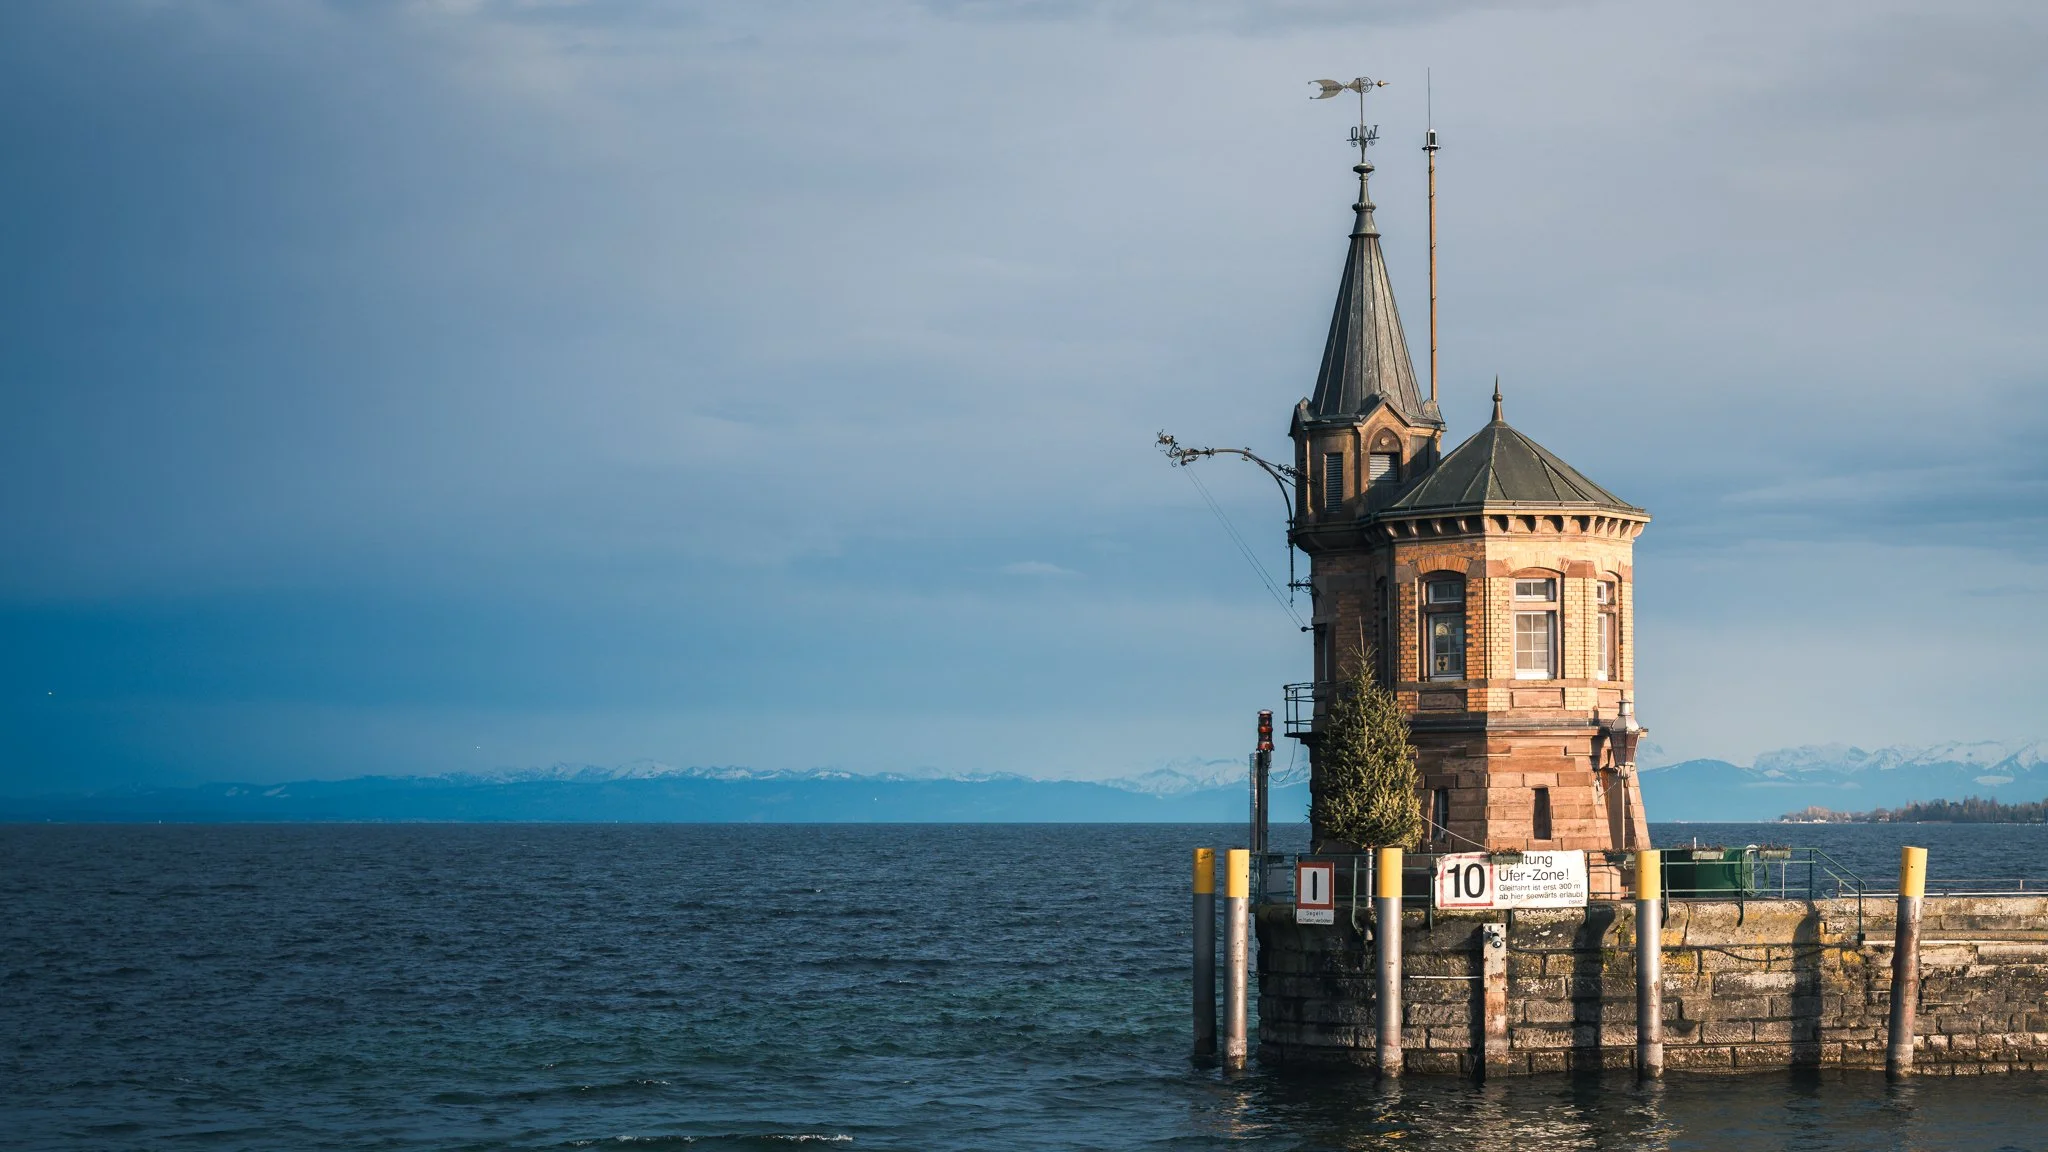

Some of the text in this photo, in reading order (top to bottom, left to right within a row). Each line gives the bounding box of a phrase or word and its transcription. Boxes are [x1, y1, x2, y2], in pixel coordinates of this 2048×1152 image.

[1446, 863, 1486, 899] 10
[1498, 868, 1569, 882] Ufer-Zone!
[1558, 882, 1573, 890] 300
[1510, 892, 1524, 900] hier
[1525, 891, 1558, 899] seewärts
[1559, 889, 1584, 899] erlaubt
